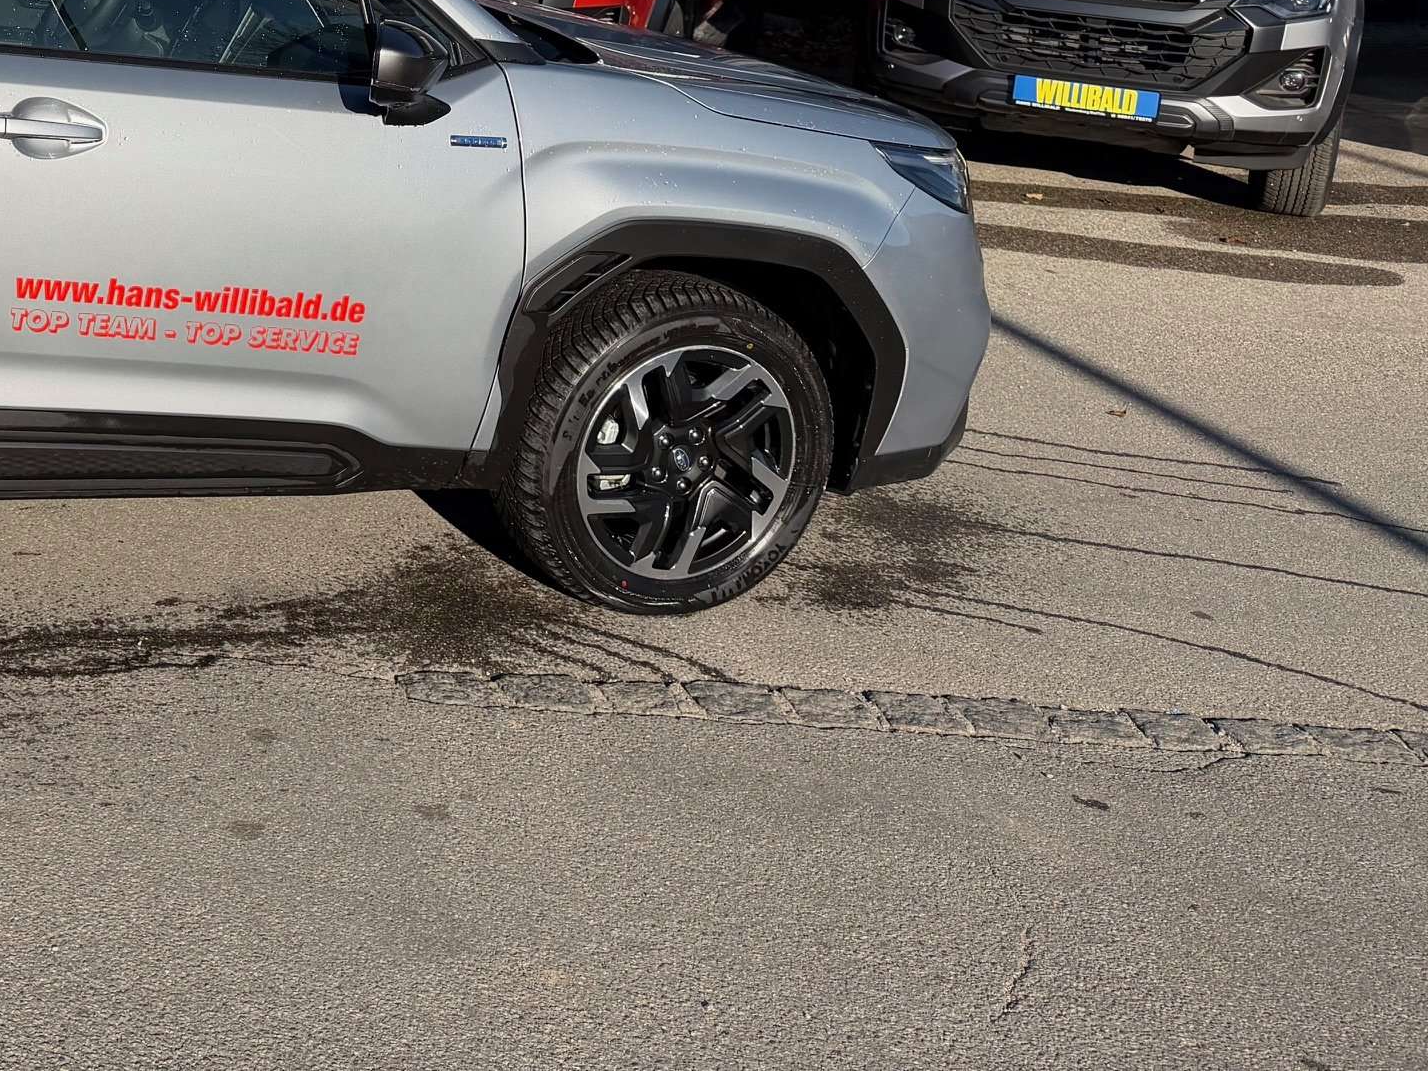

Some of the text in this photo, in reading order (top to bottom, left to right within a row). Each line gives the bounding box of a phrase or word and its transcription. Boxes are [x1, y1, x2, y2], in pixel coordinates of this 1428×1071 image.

[1035, 77, 1139, 116] WILLIBALD
[15, 277, 366, 323] www.hans-willibald.de
[10, 307, 70, 333] TOP
[78, 312, 157, 341] TEAM
[186, 320, 242, 346] TOP
[247, 325, 360, 355] SERVICE
